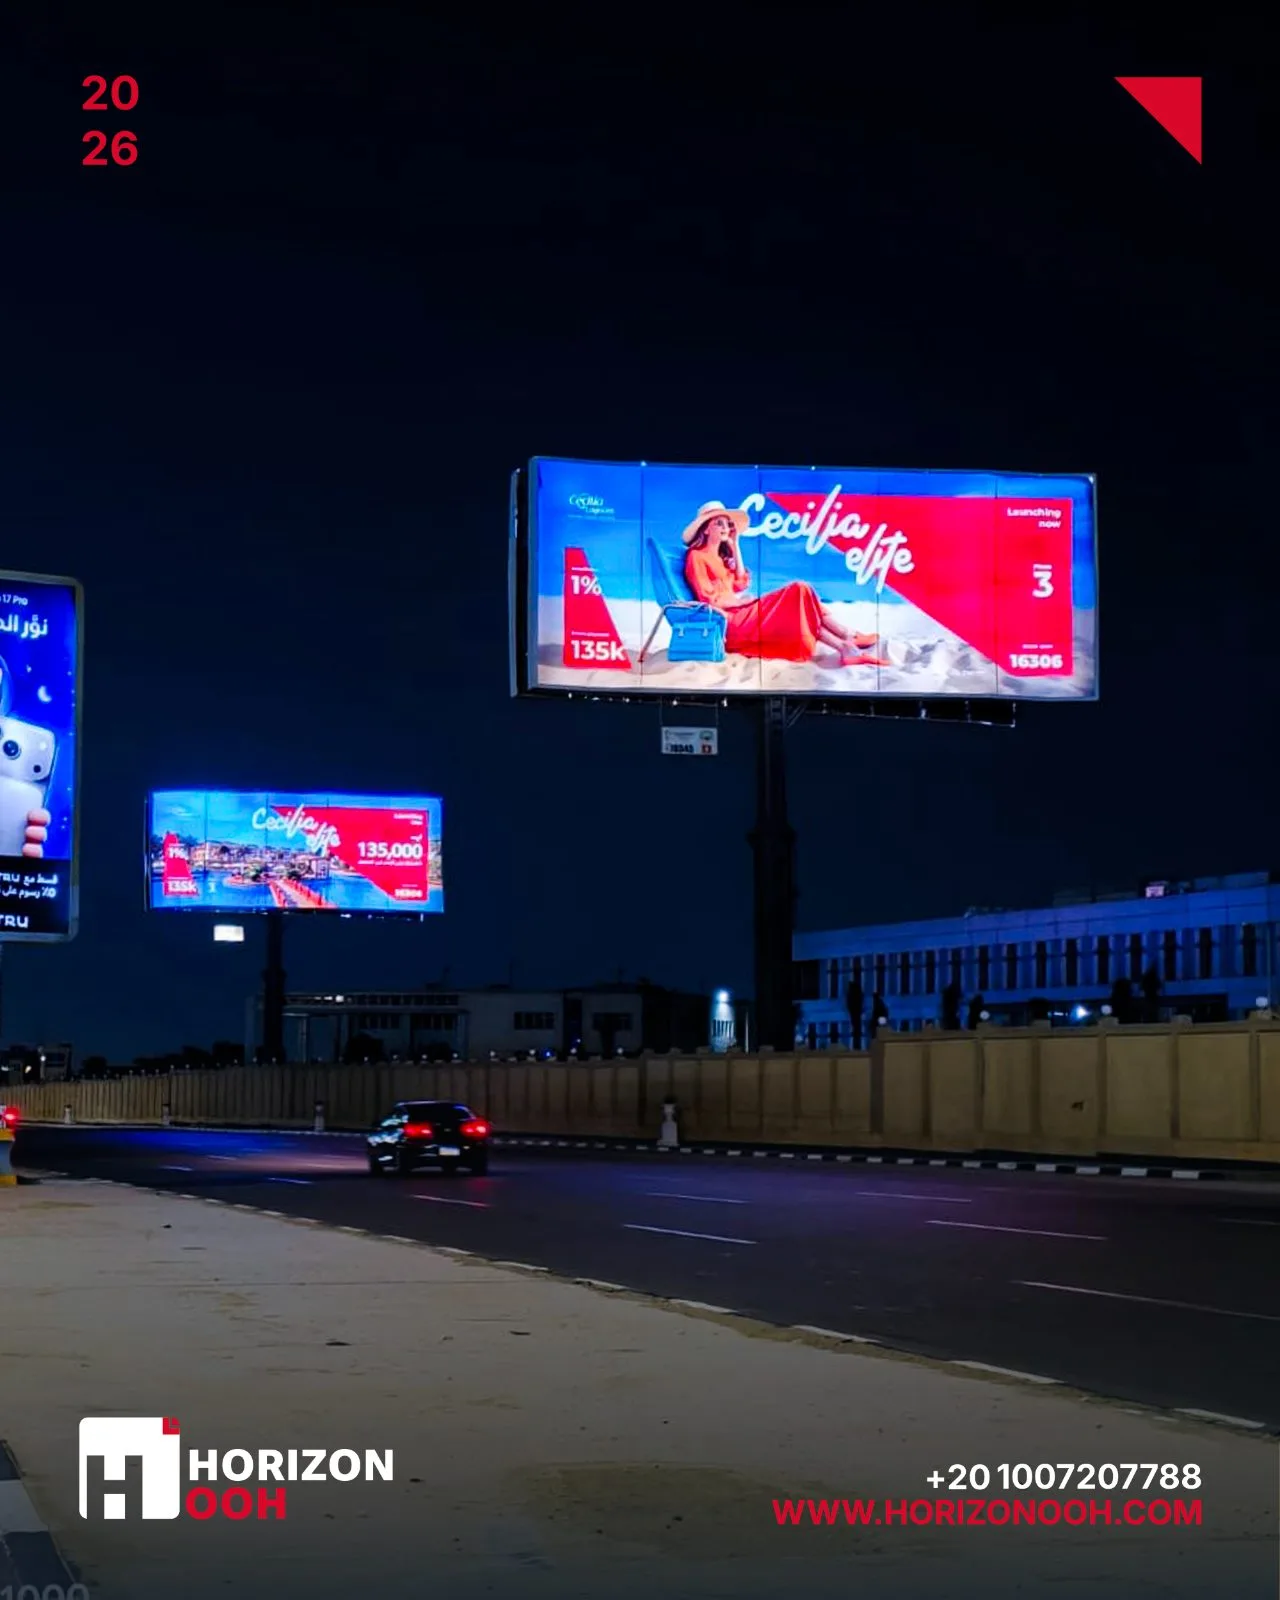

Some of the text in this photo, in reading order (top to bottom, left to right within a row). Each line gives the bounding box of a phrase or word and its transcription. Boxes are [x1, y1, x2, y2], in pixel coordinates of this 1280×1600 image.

[738, 483, 870, 555] Cecilia
[1007, 507, 1062, 519] Launching
[1038, 520, 1061, 529] now
[845, 523, 915, 594] elite
[571, 575, 602, 596] 1%
[1032, 571, 1054, 598] 3
[571, 640, 626, 661] 135k
[1009, 654, 1063, 669] 16306
[252, 803, 320, 839] Cecilia
[357, 841, 423, 860] 135,000
